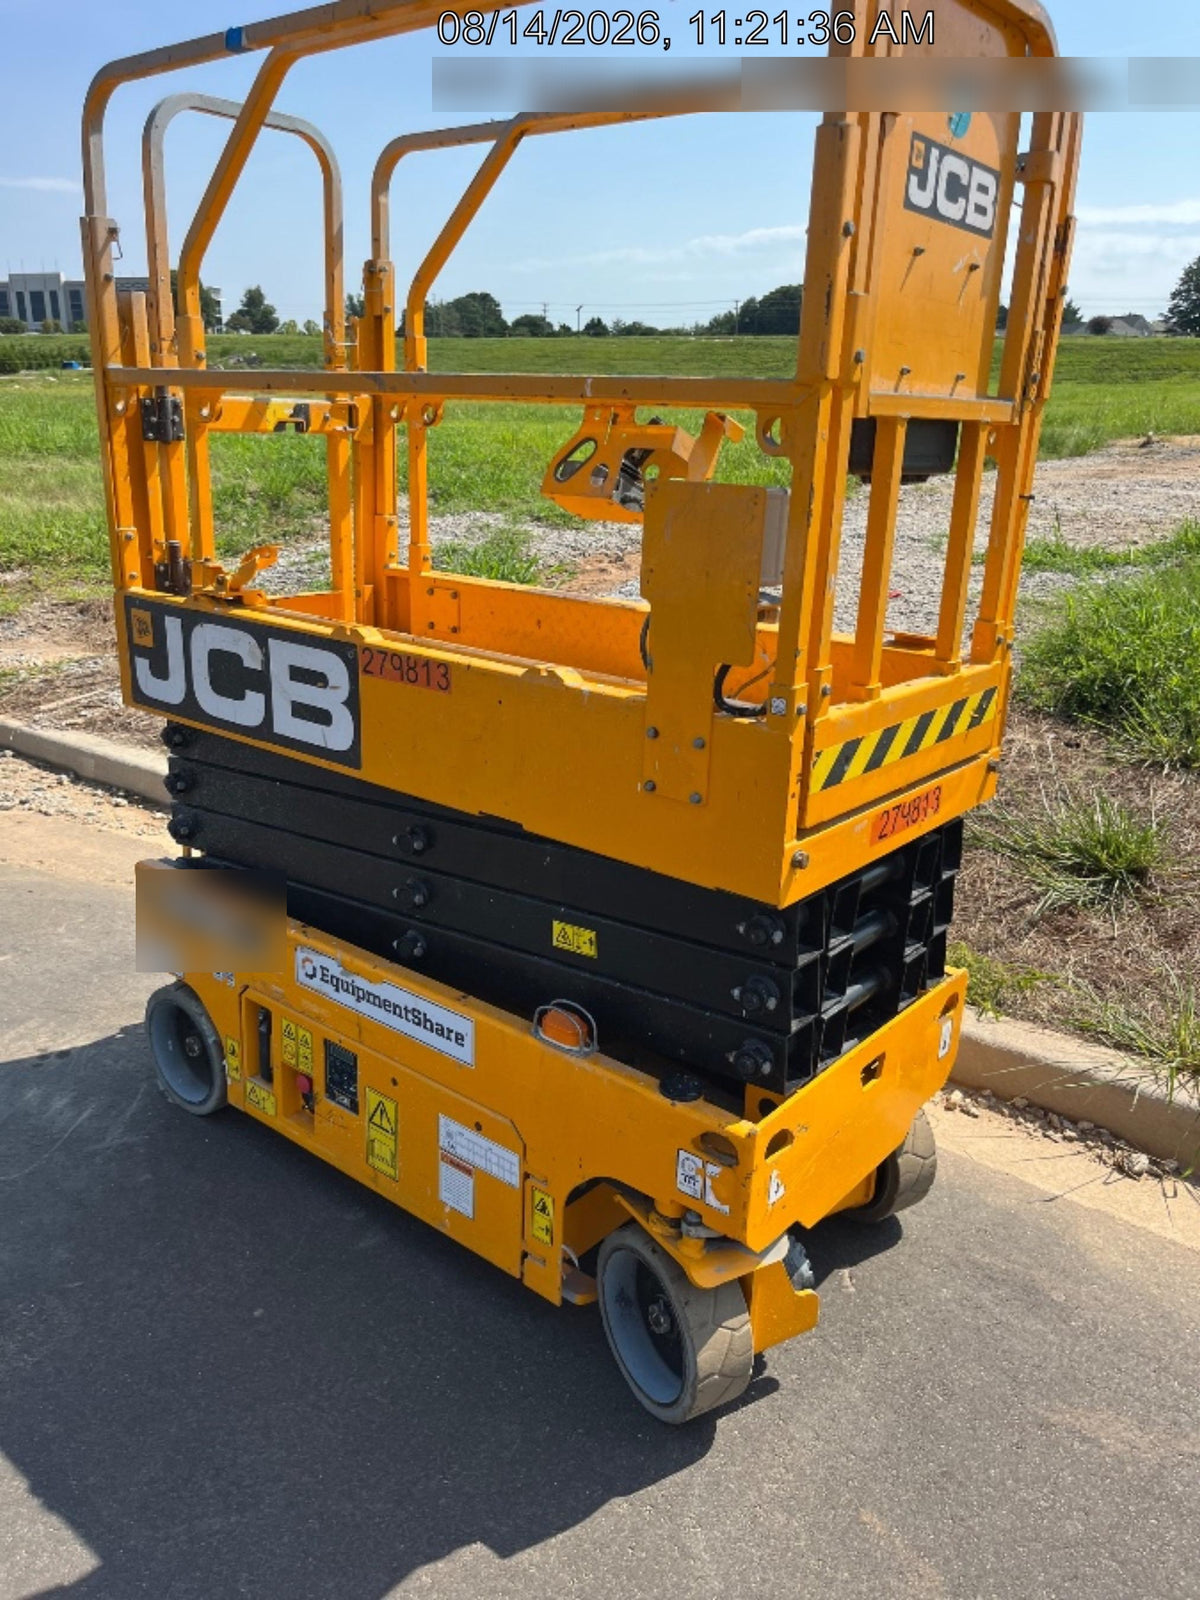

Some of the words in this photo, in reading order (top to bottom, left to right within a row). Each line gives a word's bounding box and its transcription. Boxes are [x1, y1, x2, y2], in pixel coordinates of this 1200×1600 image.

[908, 147, 997, 231] JCB
[134, 616, 355, 751] JCB
[319, 964, 466, 1048] EquipmentShare
